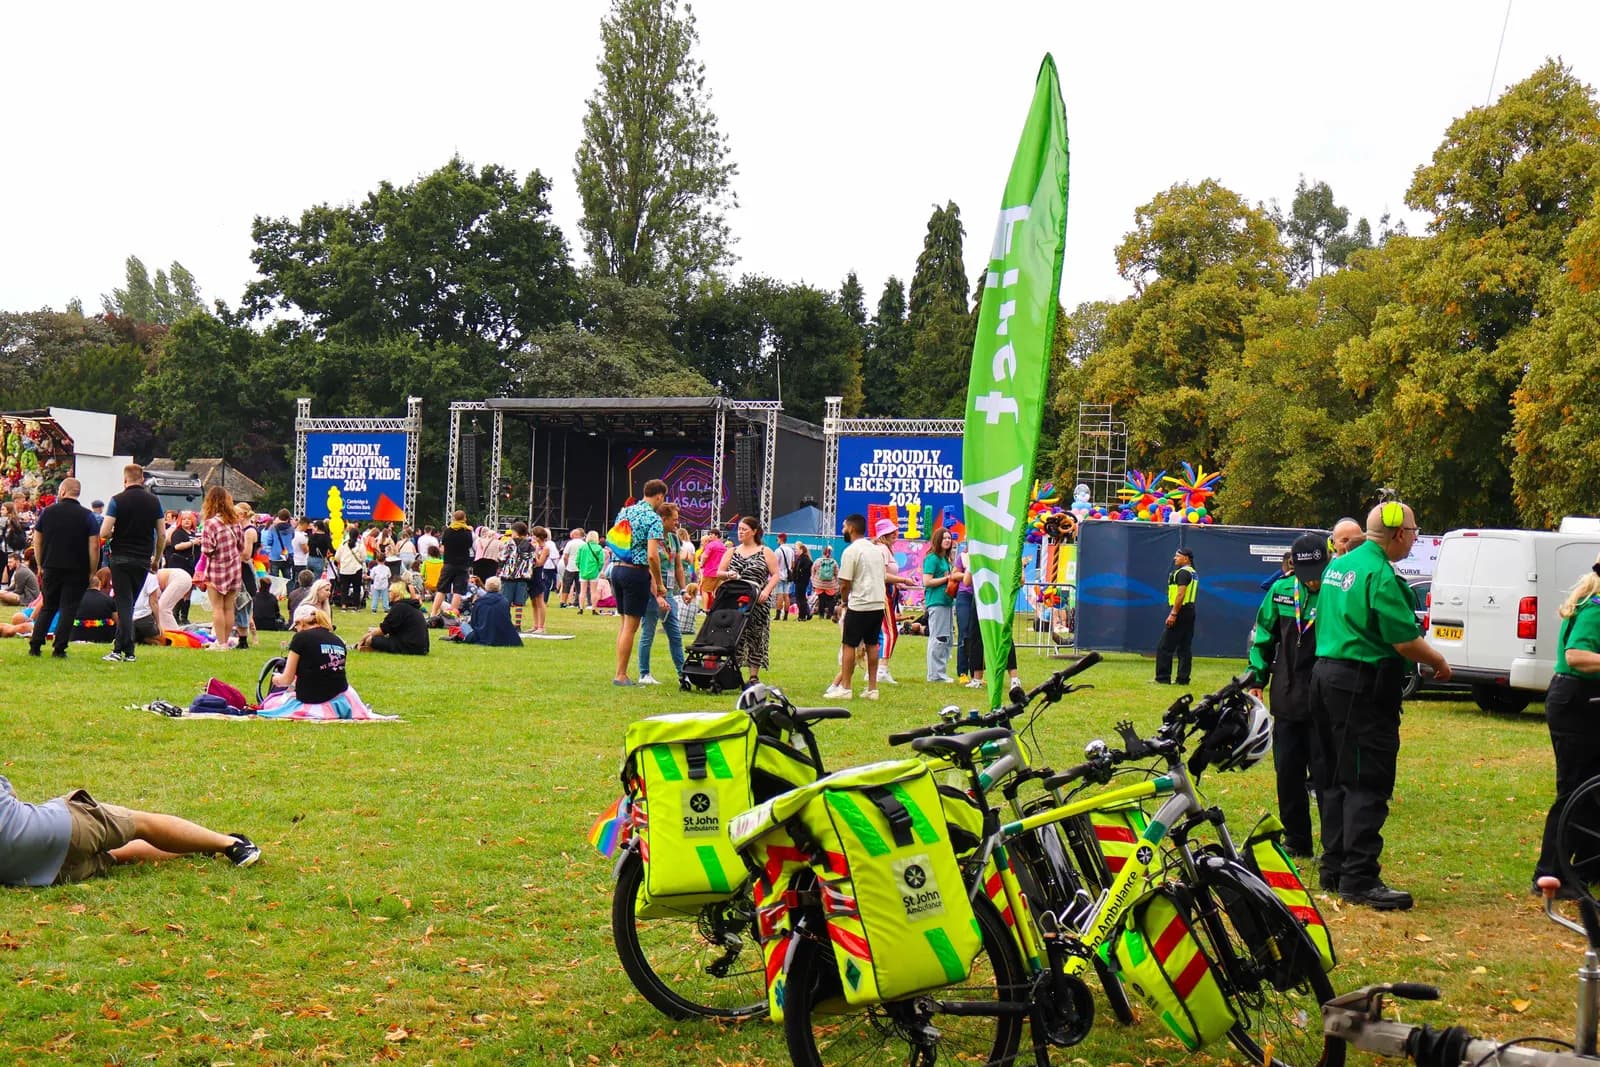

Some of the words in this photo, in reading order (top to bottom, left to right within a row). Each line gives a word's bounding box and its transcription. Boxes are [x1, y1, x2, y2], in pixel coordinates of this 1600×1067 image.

[331, 443, 381, 456] PROUDLY
[322, 455, 390, 468] SUPPORTING
[873, 449, 941, 465] PROUDLY
[311, 467, 366, 480] LEICESTER
[368, 468, 401, 481] PRIDE
[860, 463, 953, 479] SUPPORTING
[343, 480, 367, 492] 2024
[844, 477, 920, 492] LEICESTER
[889, 493, 921, 507] 2024
[683, 816, 694, 826] St
[695, 815, 719, 825] John
[903, 896, 915, 908] St
[916, 890, 940, 905] John
[906, 901, 942, 915] Ambulance
[1073, 963, 1085, 977] St
[1098, 871, 1137, 936] Ambulance
